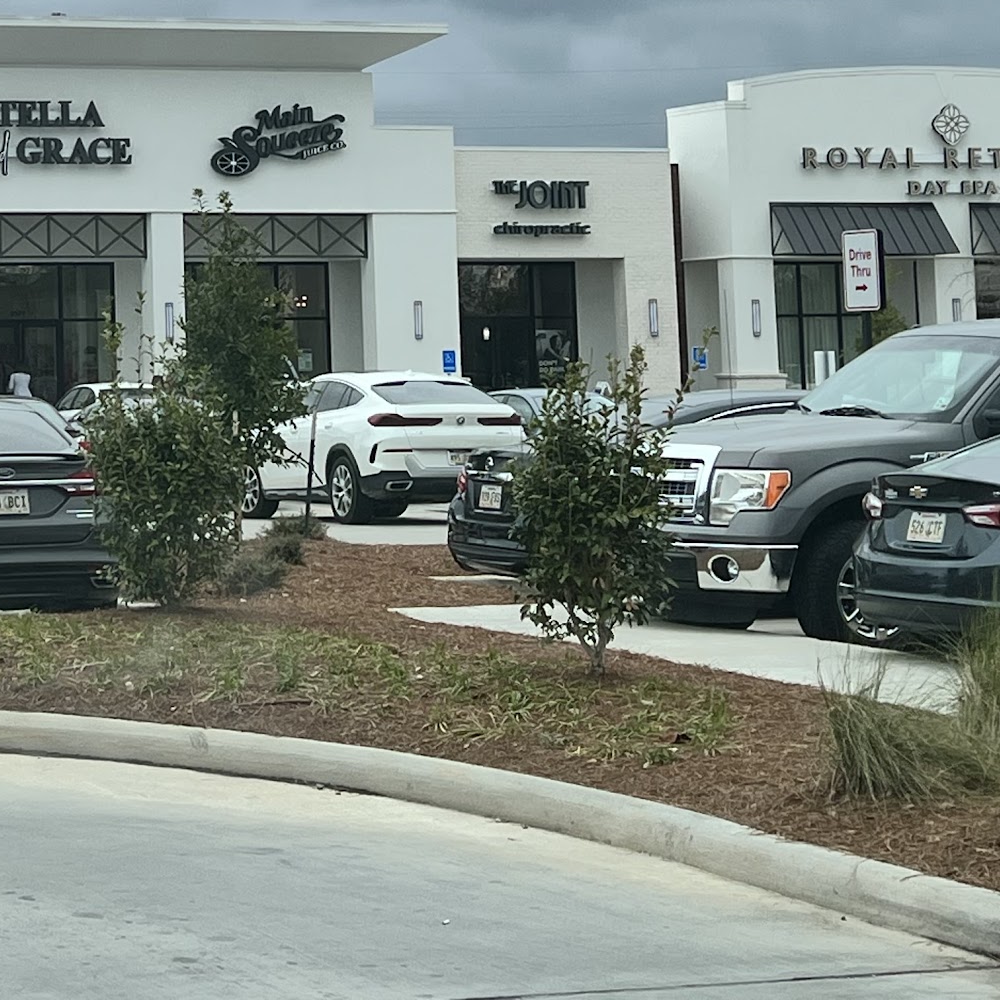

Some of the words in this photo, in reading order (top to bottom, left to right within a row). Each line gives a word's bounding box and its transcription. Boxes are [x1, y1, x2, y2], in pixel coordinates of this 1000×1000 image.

[255, 103, 314, 133] Main
[226, 113, 345, 165] Squeeze
[16, 137, 132, 164] GRACE
[302, 144, 329, 159] JUICE
[802, 147, 920, 169] ROYAL
[515, 179, 590, 210] JOINT
[907, 180, 949, 195] DAY
[960, 180, 998, 195] SPA
[493, 221, 591, 237] chiropractic
[849, 248, 872, 261] Drive
[850, 265, 872, 277] Thru
[8, 496, 26, 508] BCI
